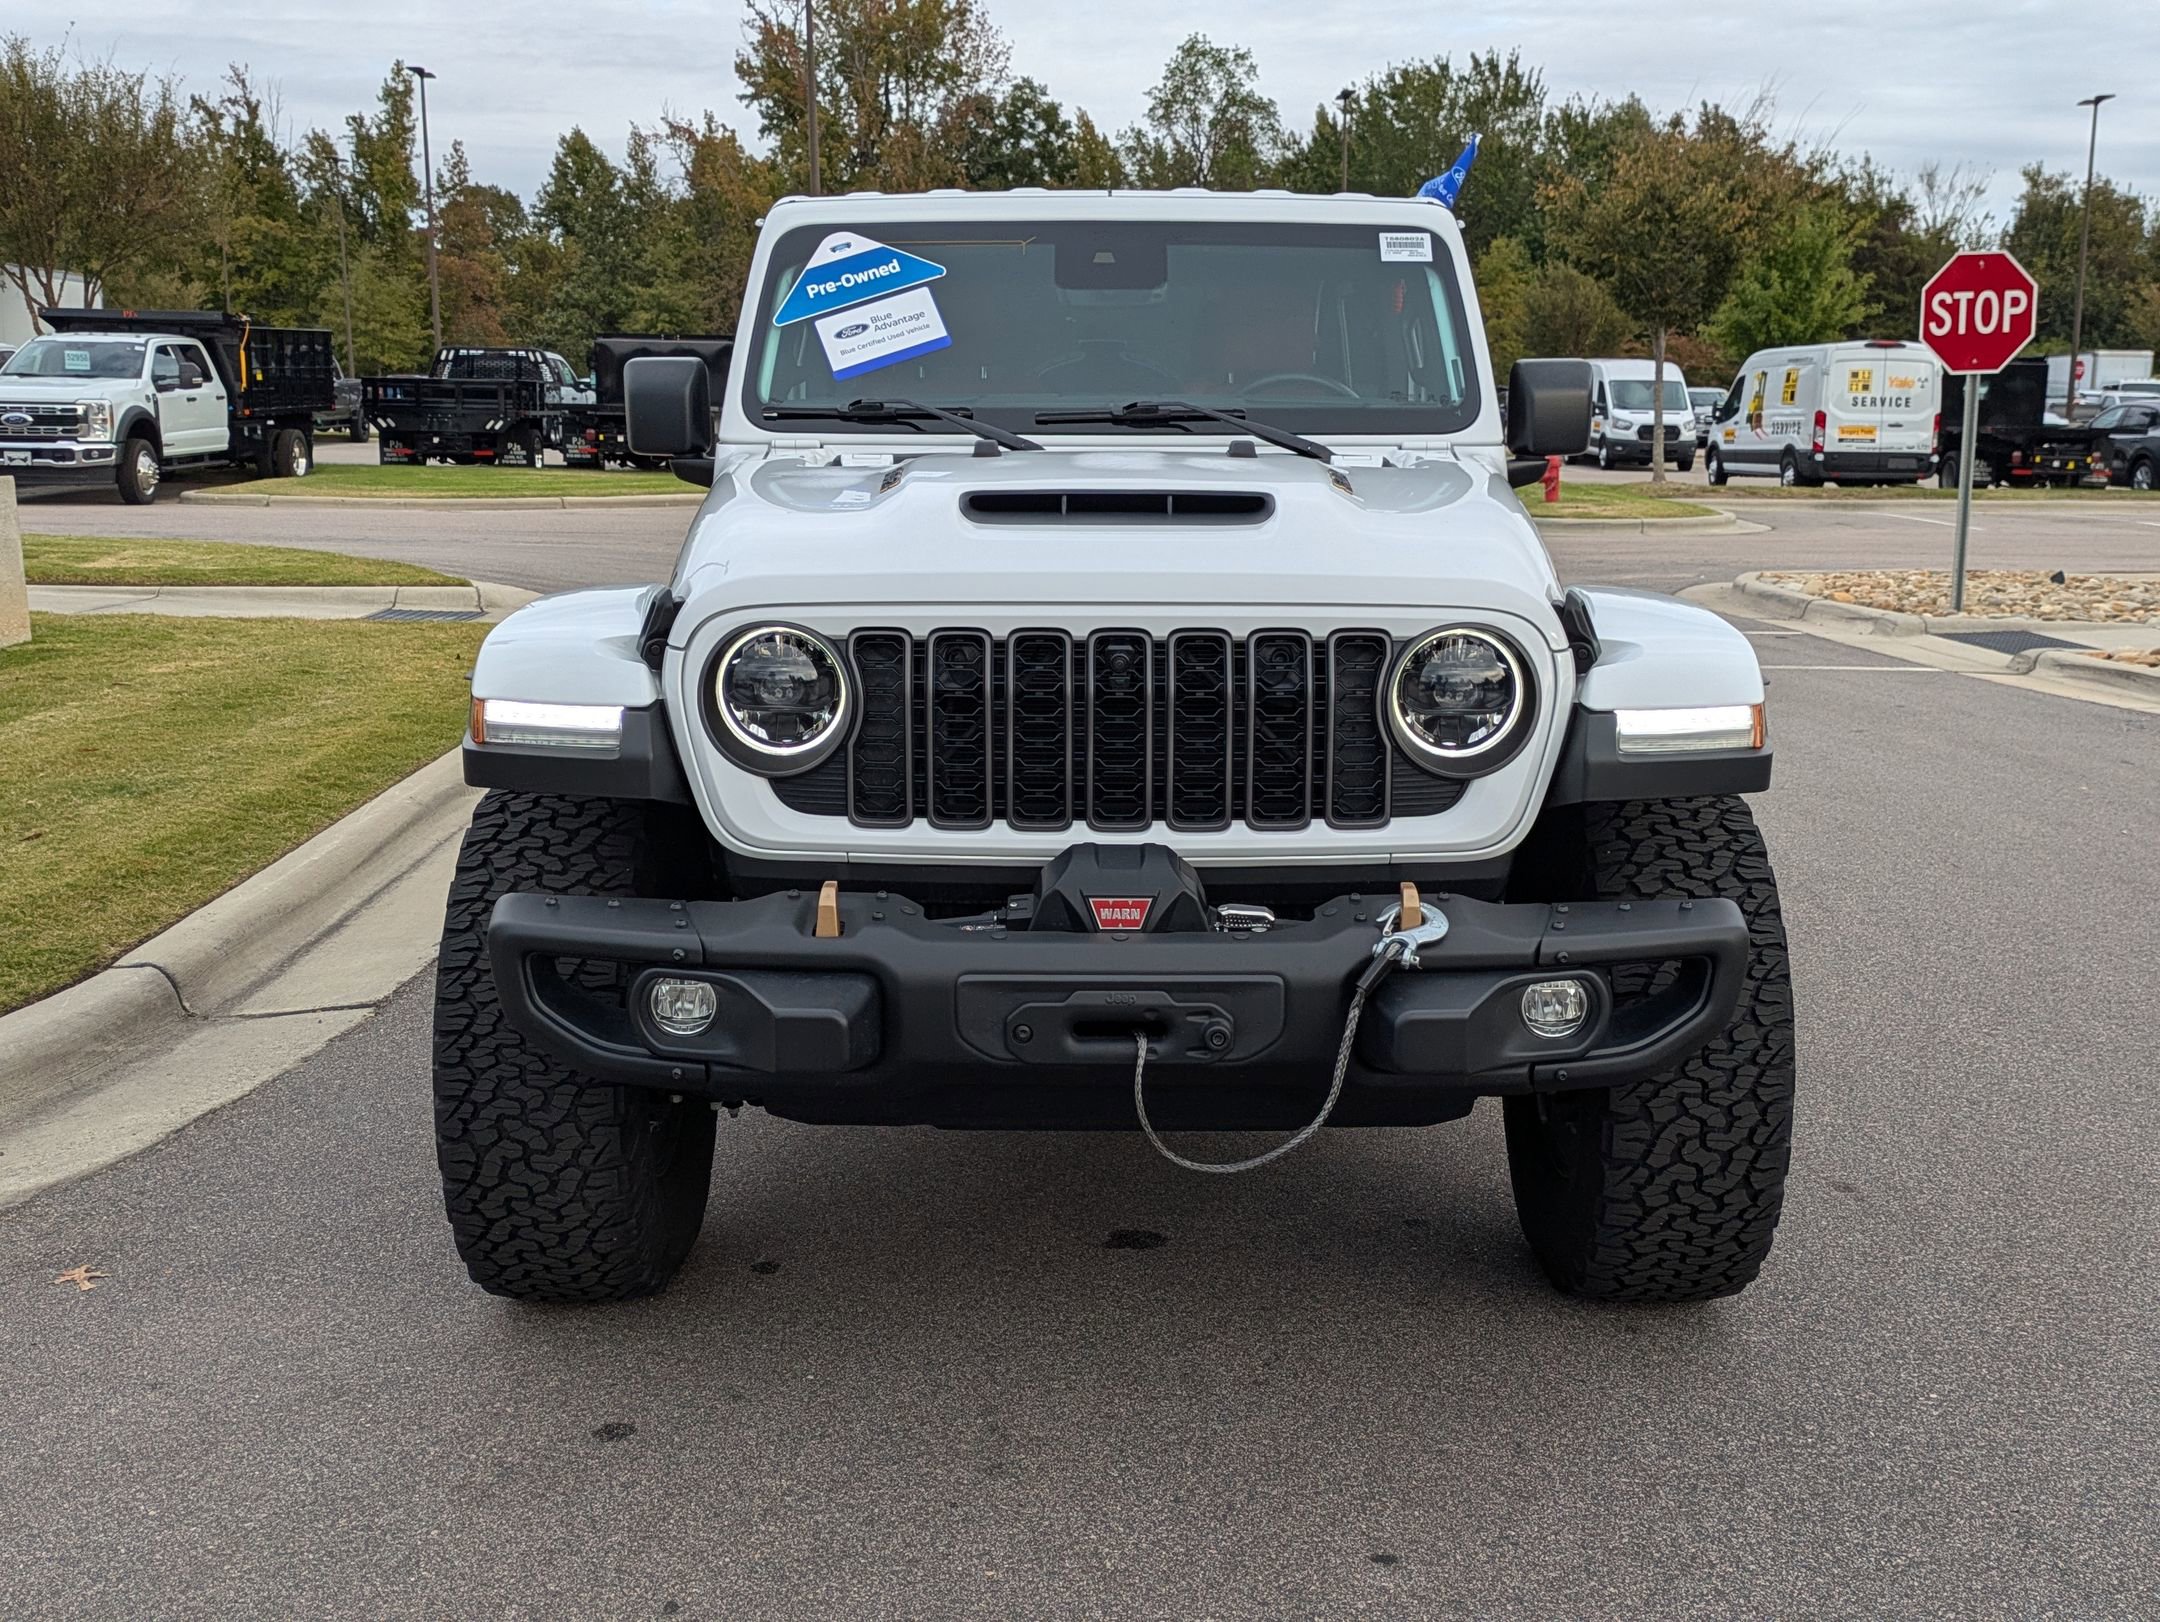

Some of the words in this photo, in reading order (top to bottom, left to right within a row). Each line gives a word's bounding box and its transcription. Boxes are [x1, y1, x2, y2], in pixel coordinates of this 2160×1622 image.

[806, 259, 901, 298] Pre-Owned
[870, 311, 893, 325] Blue
[1928, 289, 2029, 337] STOP
[874, 310, 926, 333] Advantage
[841, 325, 863, 338] Ford
[840, 347, 857, 356] Blue
[857, 336, 886, 350] Certified
[887, 331, 905, 341] Used
[905, 323, 931, 335] Vehicle
[1851, 396, 1911, 408] SERVICE
[1771, 421, 1801, 435] SERVICE
[1100, 908, 1140, 920] WARN
[1105, 992, 1136, 1005] Jeep
